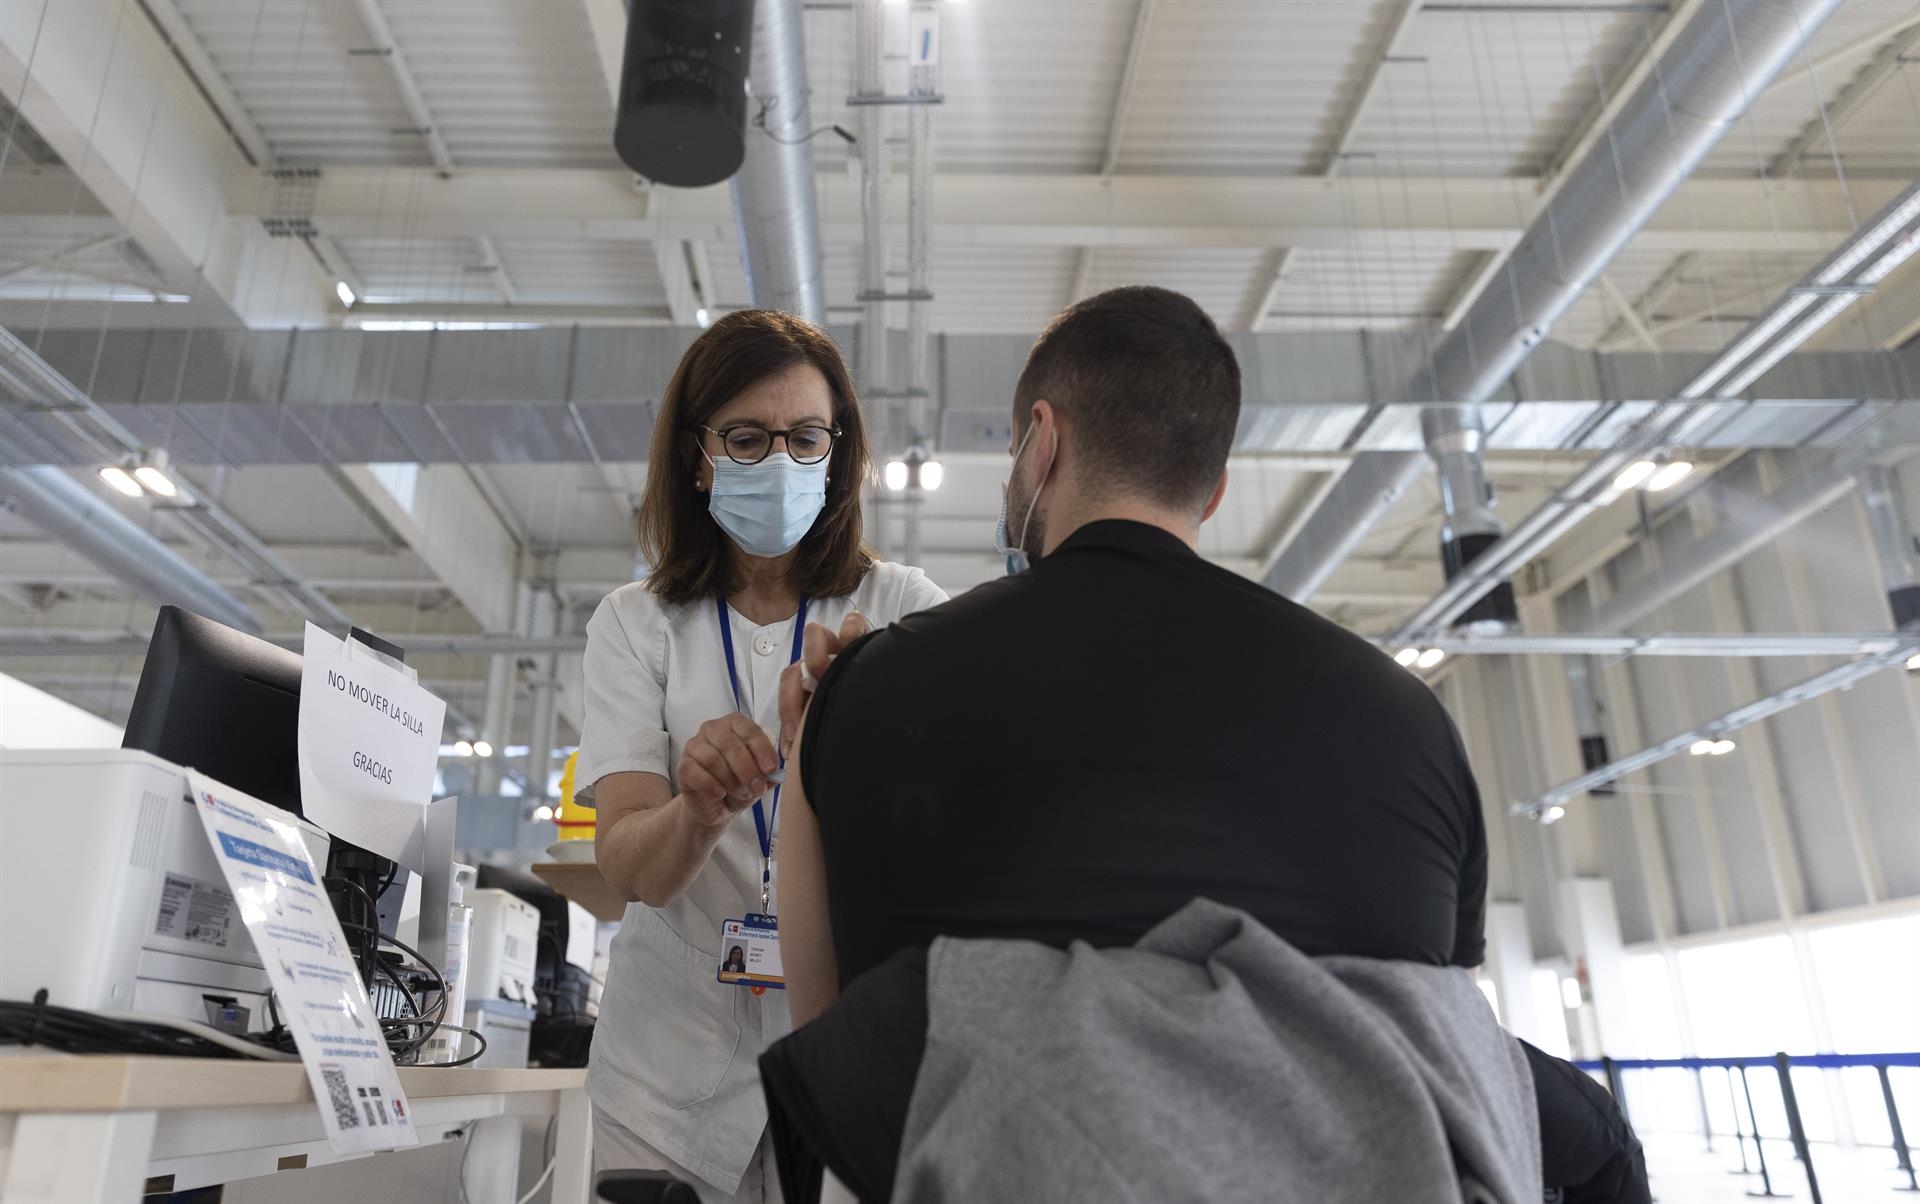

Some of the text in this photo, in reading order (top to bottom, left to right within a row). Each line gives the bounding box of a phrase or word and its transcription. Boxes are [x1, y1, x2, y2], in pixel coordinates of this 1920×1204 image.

[328, 670, 423, 736] NO MOVER LA SILLA
[353, 751, 392, 785] GRACIAS
